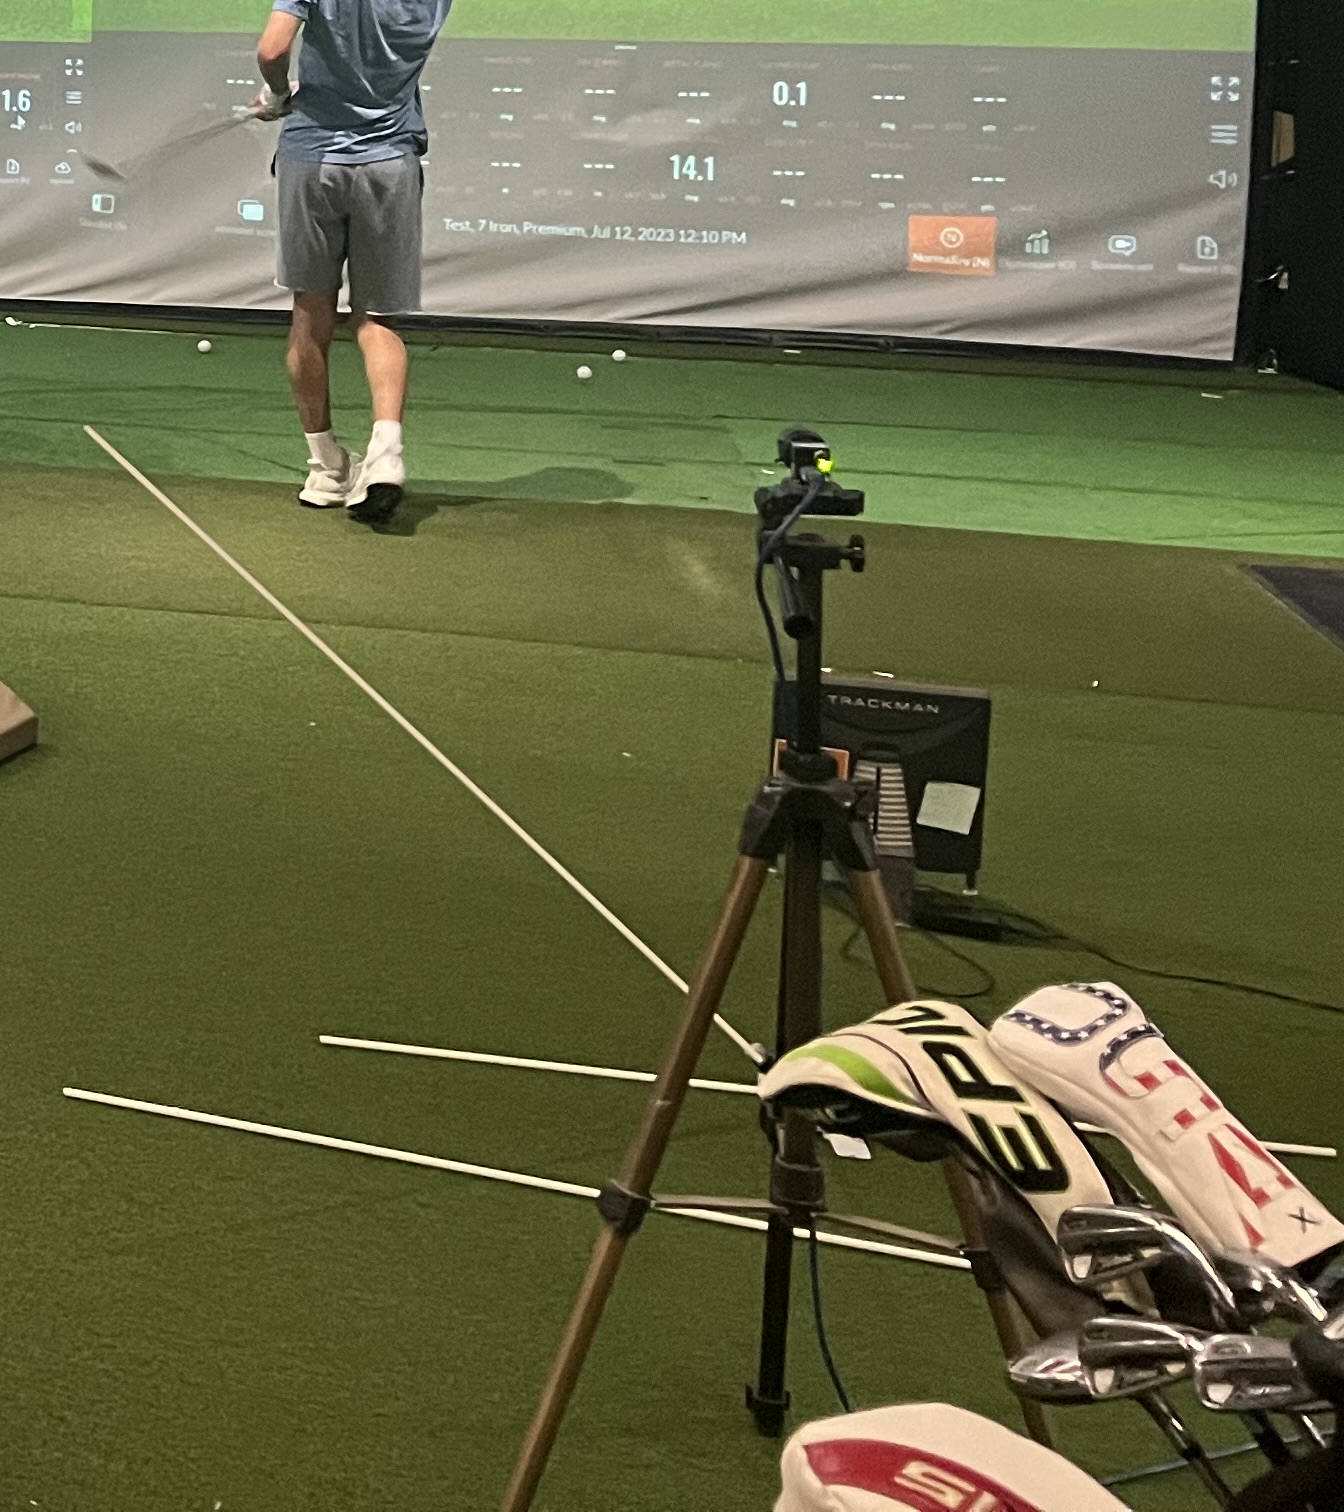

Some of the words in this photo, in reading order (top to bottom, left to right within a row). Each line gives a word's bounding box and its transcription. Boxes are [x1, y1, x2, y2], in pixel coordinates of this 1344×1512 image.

[1, 89, 32, 113] 1.6
[772, 81, 808, 106] 0.1
[670, 154, 715, 181] 14.1
[478, 220, 486, 232] 7
[489, 220, 521, 235] Iron,
[524, 222, 588, 238] Premium,
[590, 225, 611, 239] Jul
[614, 227, 635, 241] 12,
[638, 228, 675, 242] 2023
[678, 230, 720, 244] 12:10
[722, 231, 747, 244] PM
[827, 694, 940, 714] TRACKMAN
